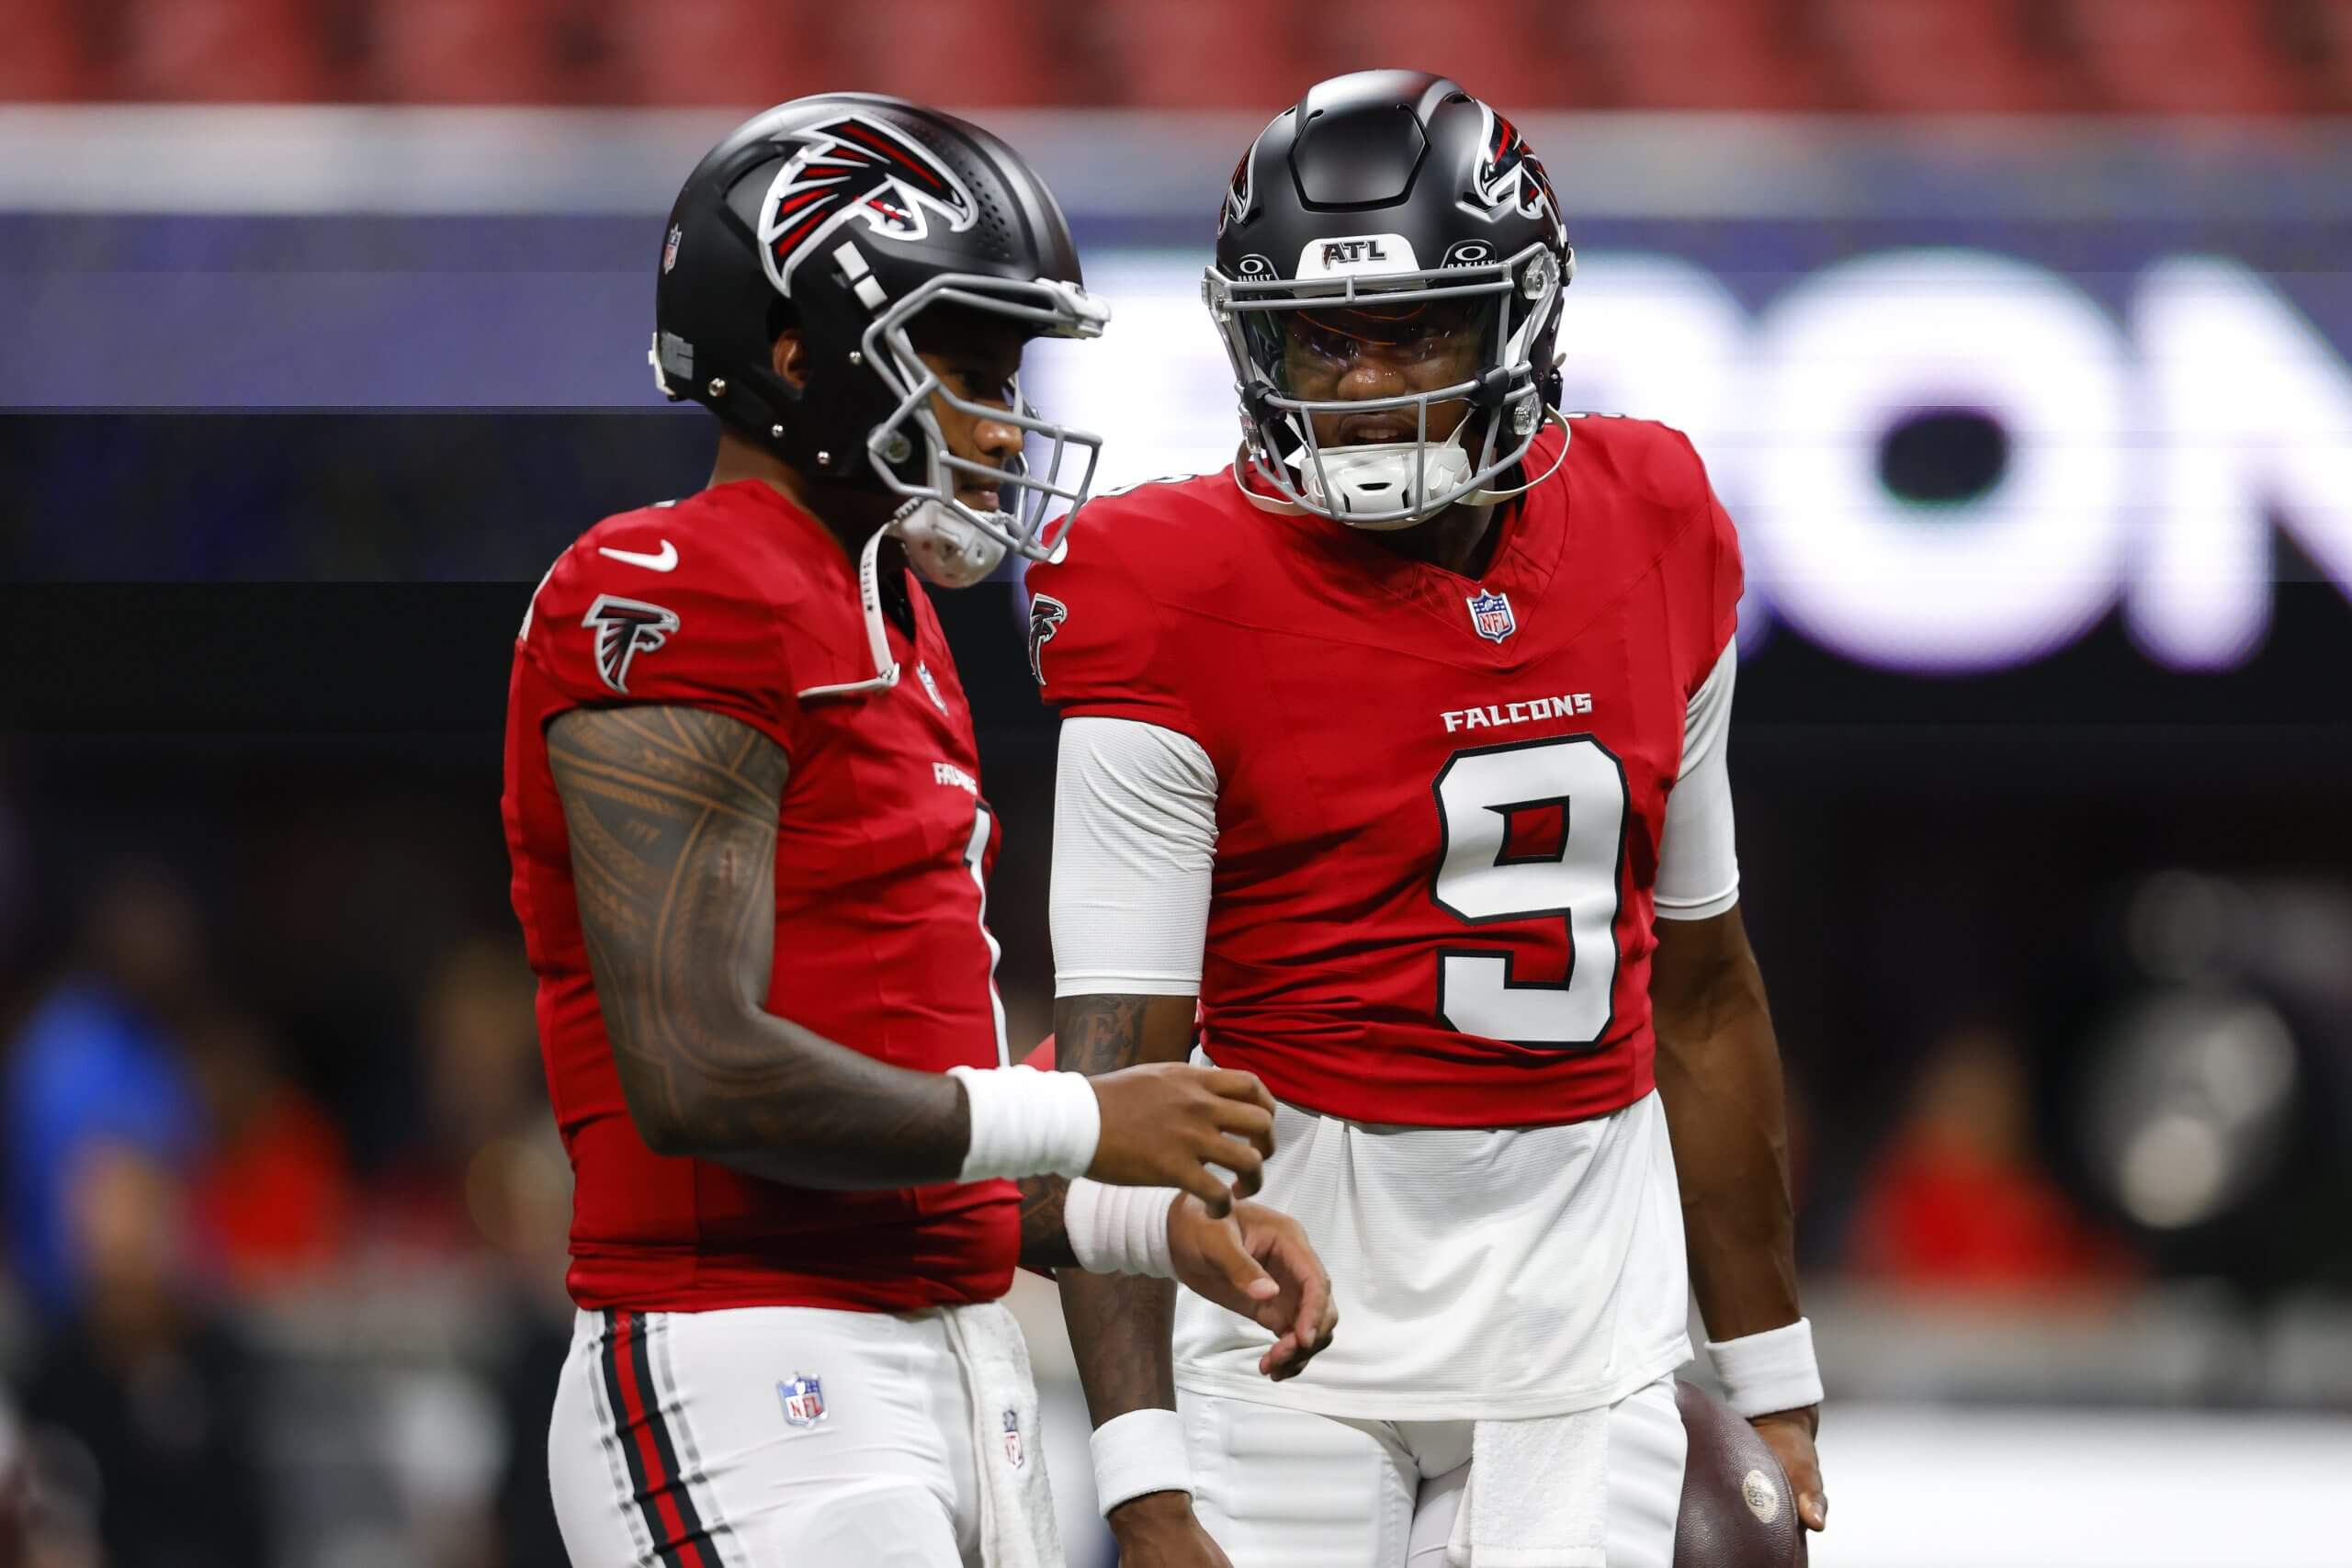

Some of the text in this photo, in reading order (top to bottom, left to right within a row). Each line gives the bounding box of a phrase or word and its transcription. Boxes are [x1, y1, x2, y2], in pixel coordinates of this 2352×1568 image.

[1322, 240, 1387, 270] ATL
[1480, 613, 1510, 633] NFL
[1440, 693, 1593, 733] FALCONS
[1430, 732, 1631, 1049] 9
[790, 1395, 821, 1419] NFL
